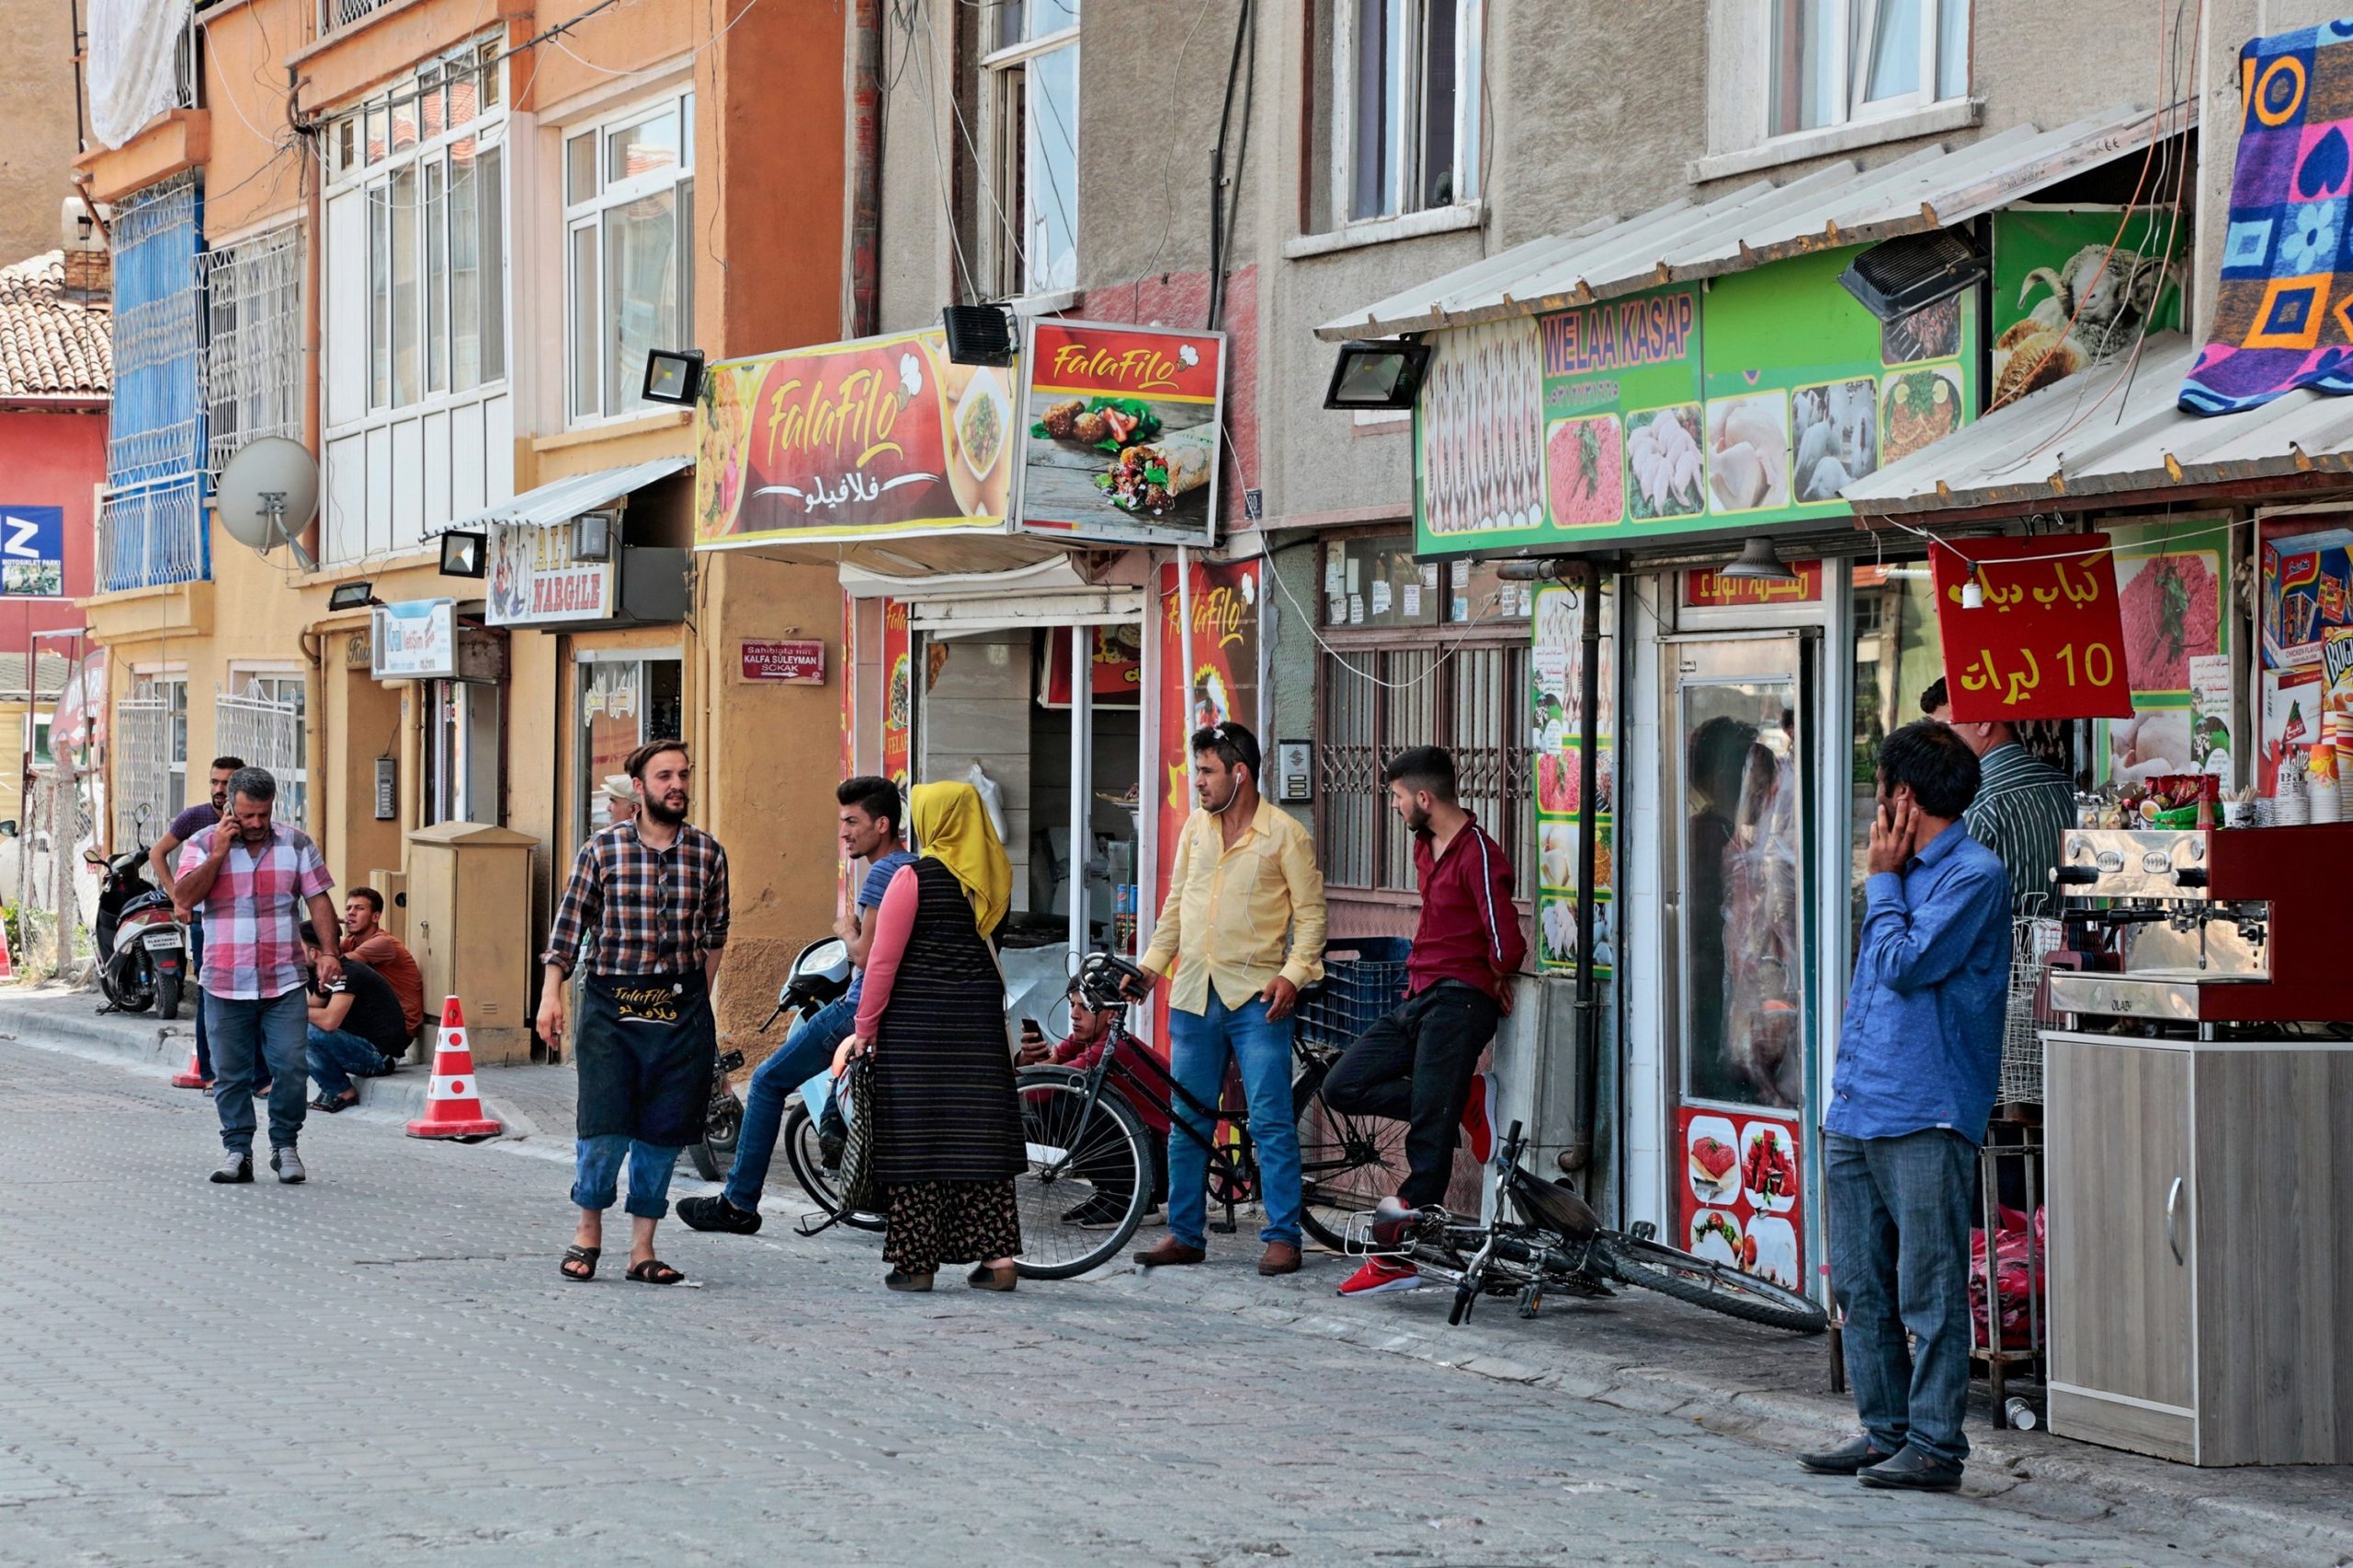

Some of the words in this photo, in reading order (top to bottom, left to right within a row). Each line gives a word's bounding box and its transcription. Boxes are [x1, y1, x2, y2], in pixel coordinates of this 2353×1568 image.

[1541, 305, 1618, 378] WELAA
[1620, 292, 1693, 368] KASAP
[1054, 344, 1179, 390] FalaFilo
[768, 368, 904, 468] FalaFilo
[804, 472, 879, 513] فلافيلو
[2033, 540, 2111, 610] كباب
[744, 654, 770, 664] KALFA
[772, 653, 817, 665] SÜLEYMAN
[761, 664, 799, 672] SOKAK
[2056, 643, 2113, 687] 10
[2285, 648, 2304, 658] CHICKEN
[1961, 648, 2040, 705] ليرات
[615, 987, 673, 1006] FalaFilo
